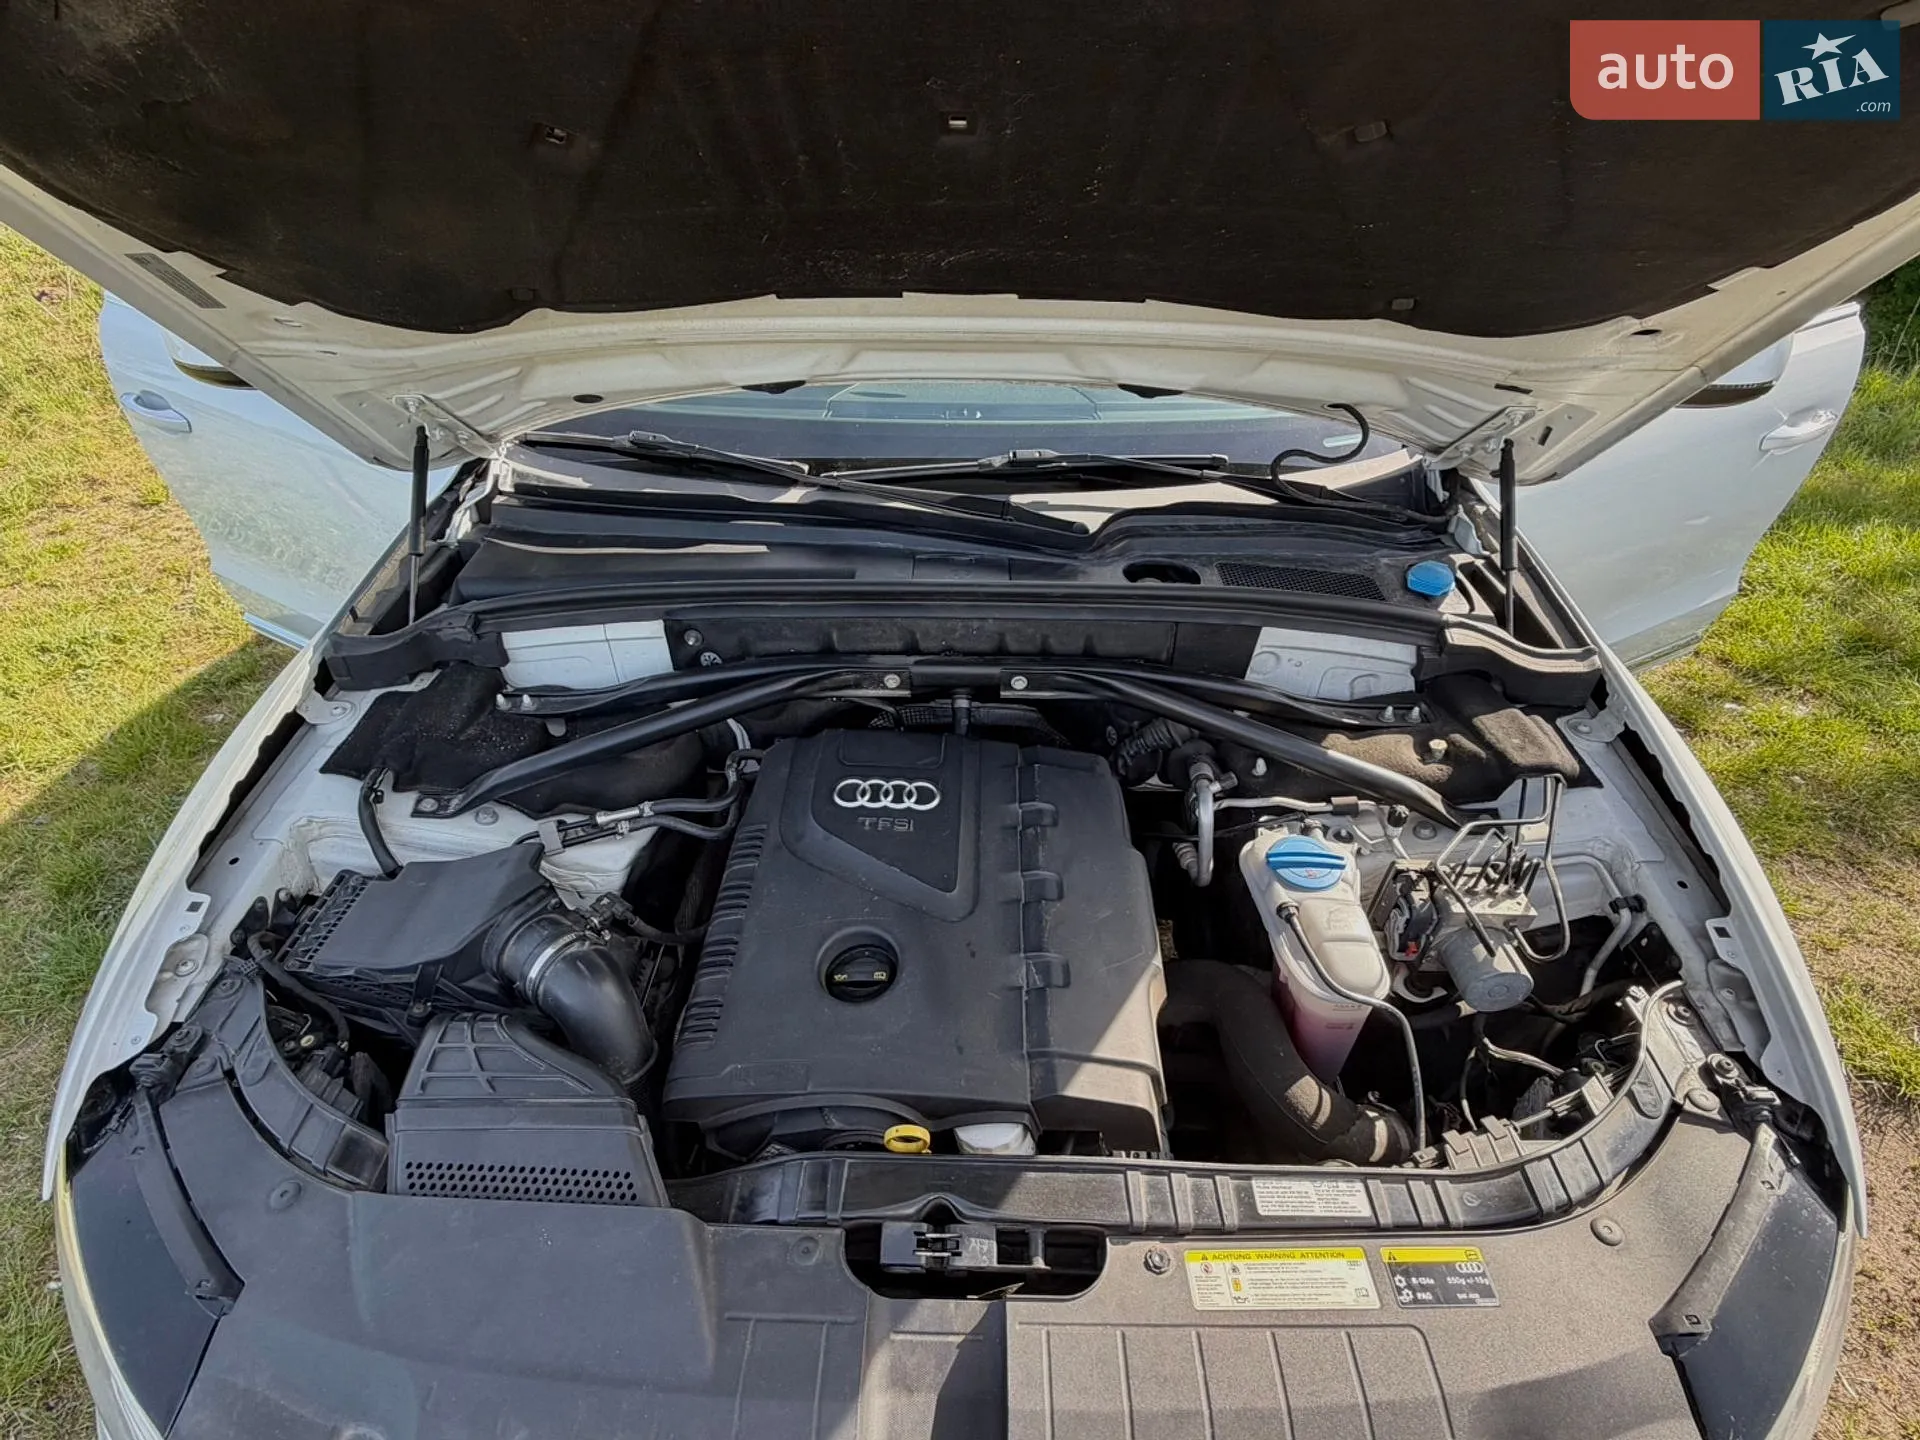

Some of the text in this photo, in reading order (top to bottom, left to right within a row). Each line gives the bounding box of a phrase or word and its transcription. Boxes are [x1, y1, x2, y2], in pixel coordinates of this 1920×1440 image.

[857, 816, 914, 832] TFSI
[1212, 1251, 1345, 1260] ACHTUNG WARNING ATTENTION
